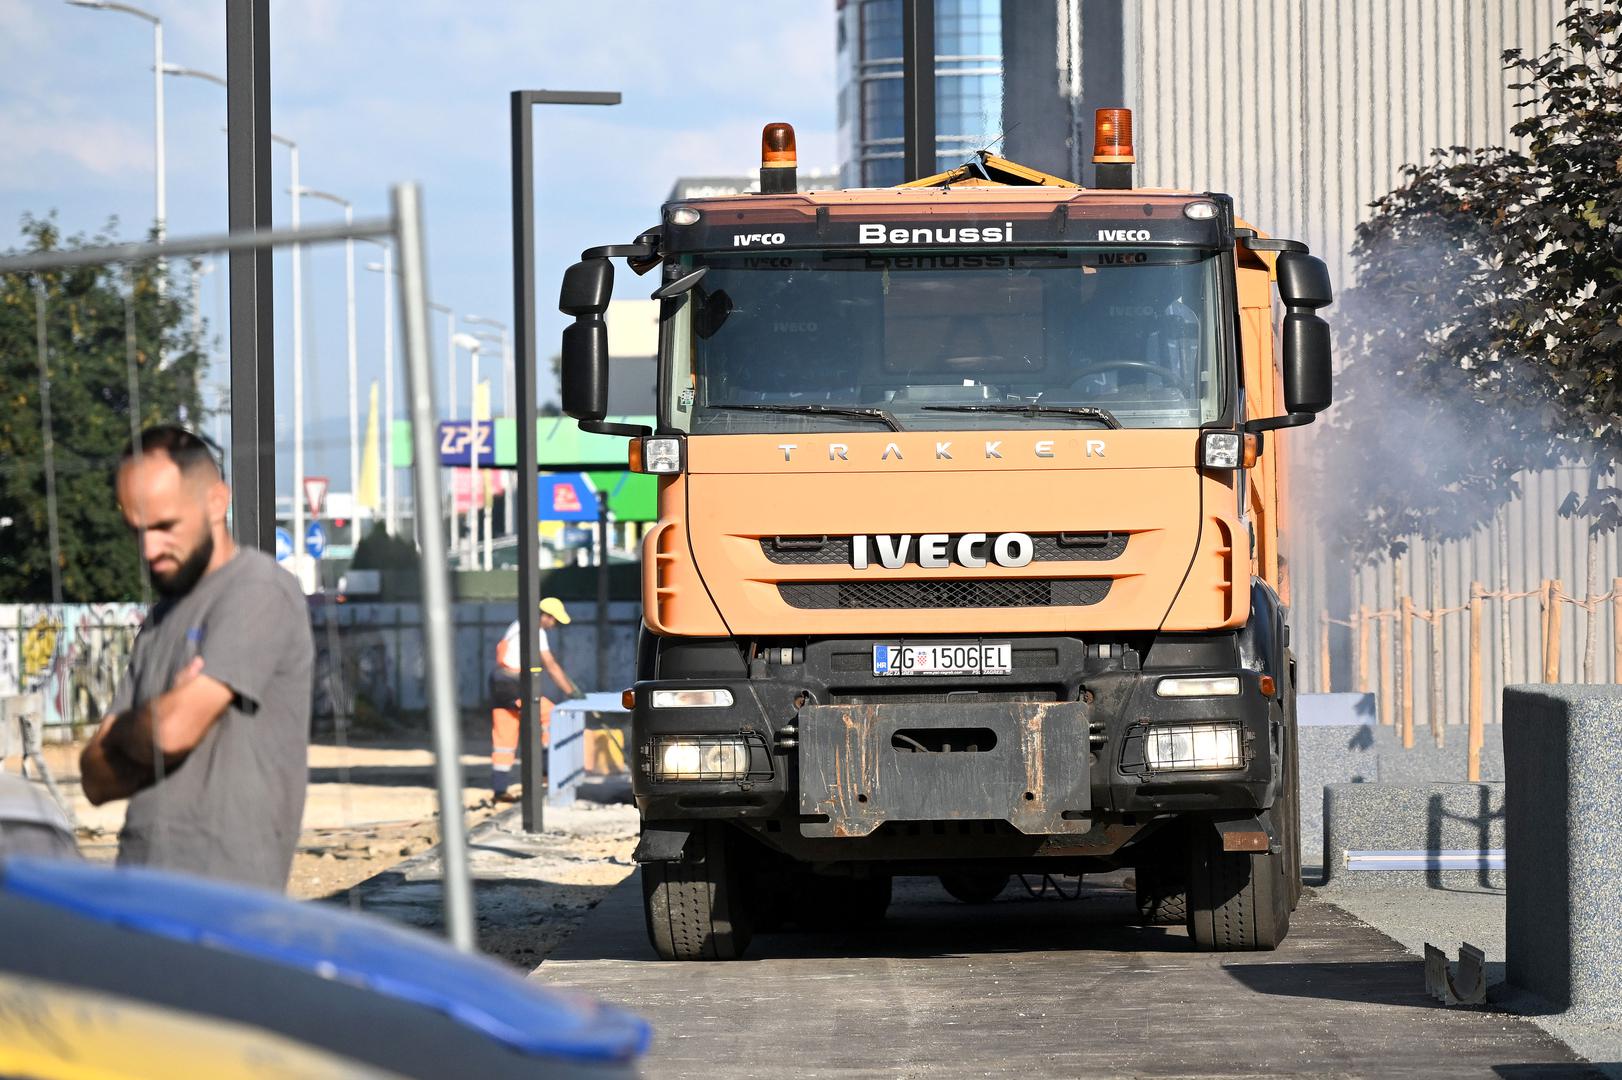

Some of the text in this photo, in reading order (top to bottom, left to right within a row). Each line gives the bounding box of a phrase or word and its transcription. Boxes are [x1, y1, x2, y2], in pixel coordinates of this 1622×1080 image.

[858, 221, 1013, 244] Benussi
[1098, 229, 1152, 241] IVECO
[773, 322, 818, 332] IVECO
[440, 425, 492, 454] ZPZ
[778, 440, 1106, 462] TRAKKER
[852, 532, 1034, 570] IVECO
[890, 647, 1007, 669] ZG 1506 EL
